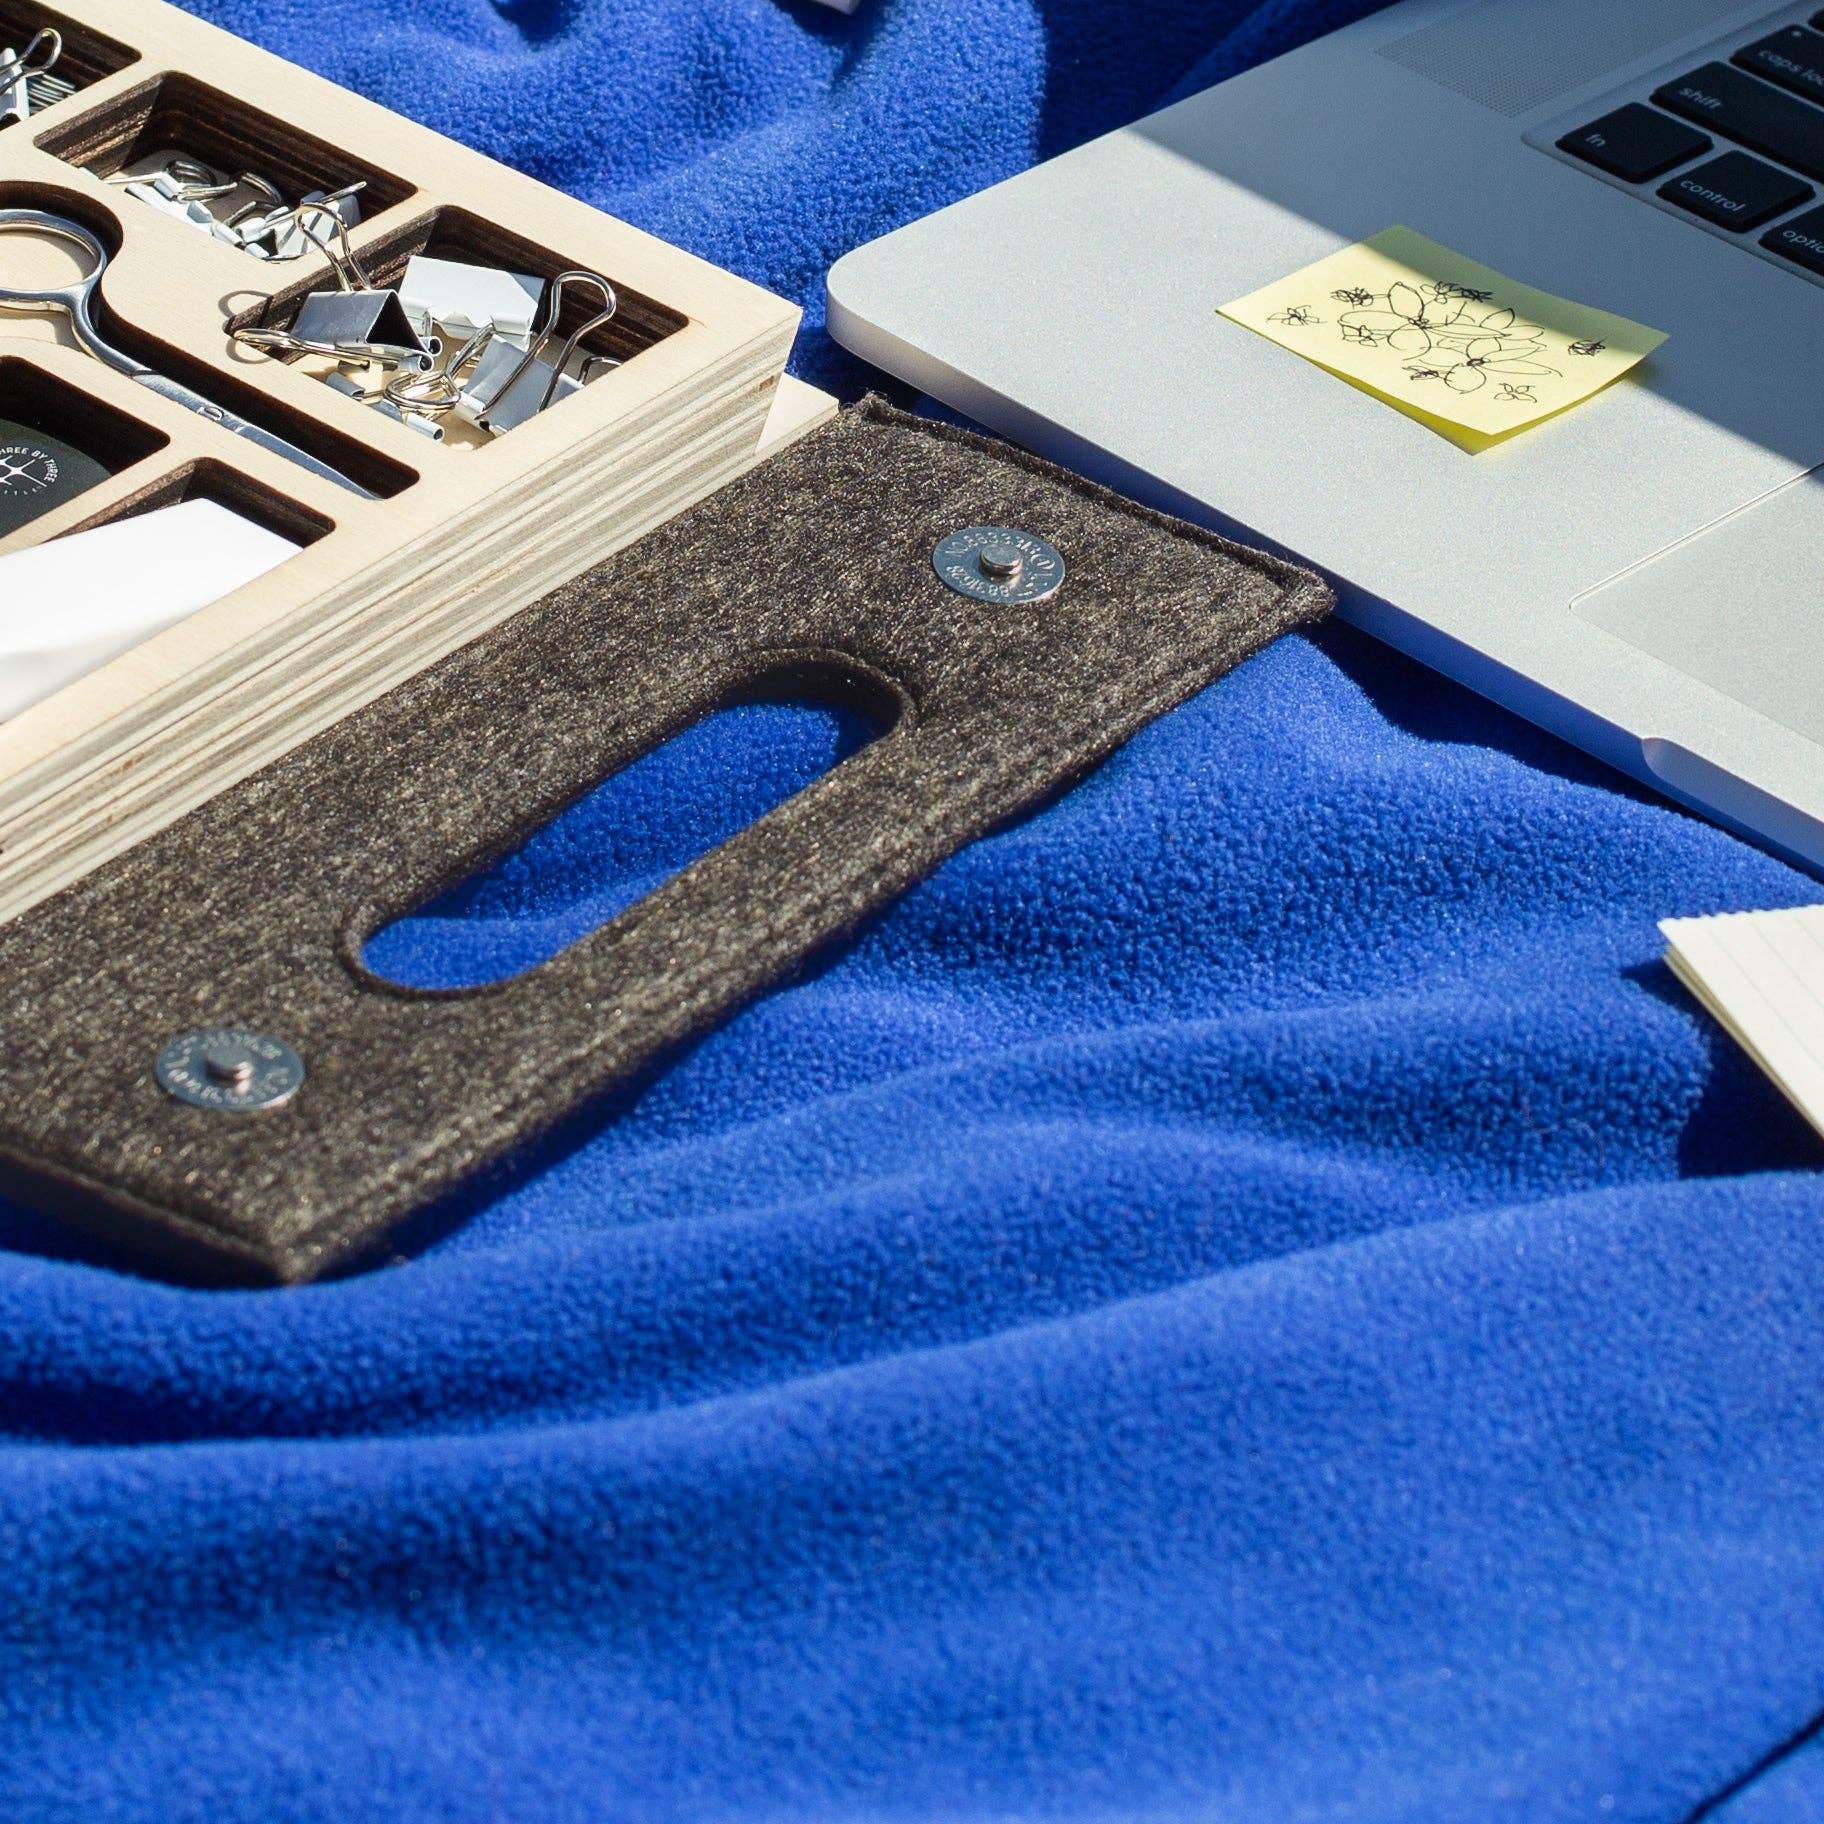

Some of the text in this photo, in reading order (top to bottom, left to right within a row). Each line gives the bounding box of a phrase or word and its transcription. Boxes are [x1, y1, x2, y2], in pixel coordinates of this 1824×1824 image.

[1678, 83, 1724, 113] shift
[1678, 176, 1748, 216] control
[31, 450, 49, 462] BY
[43, 458, 60, 483] THREE
